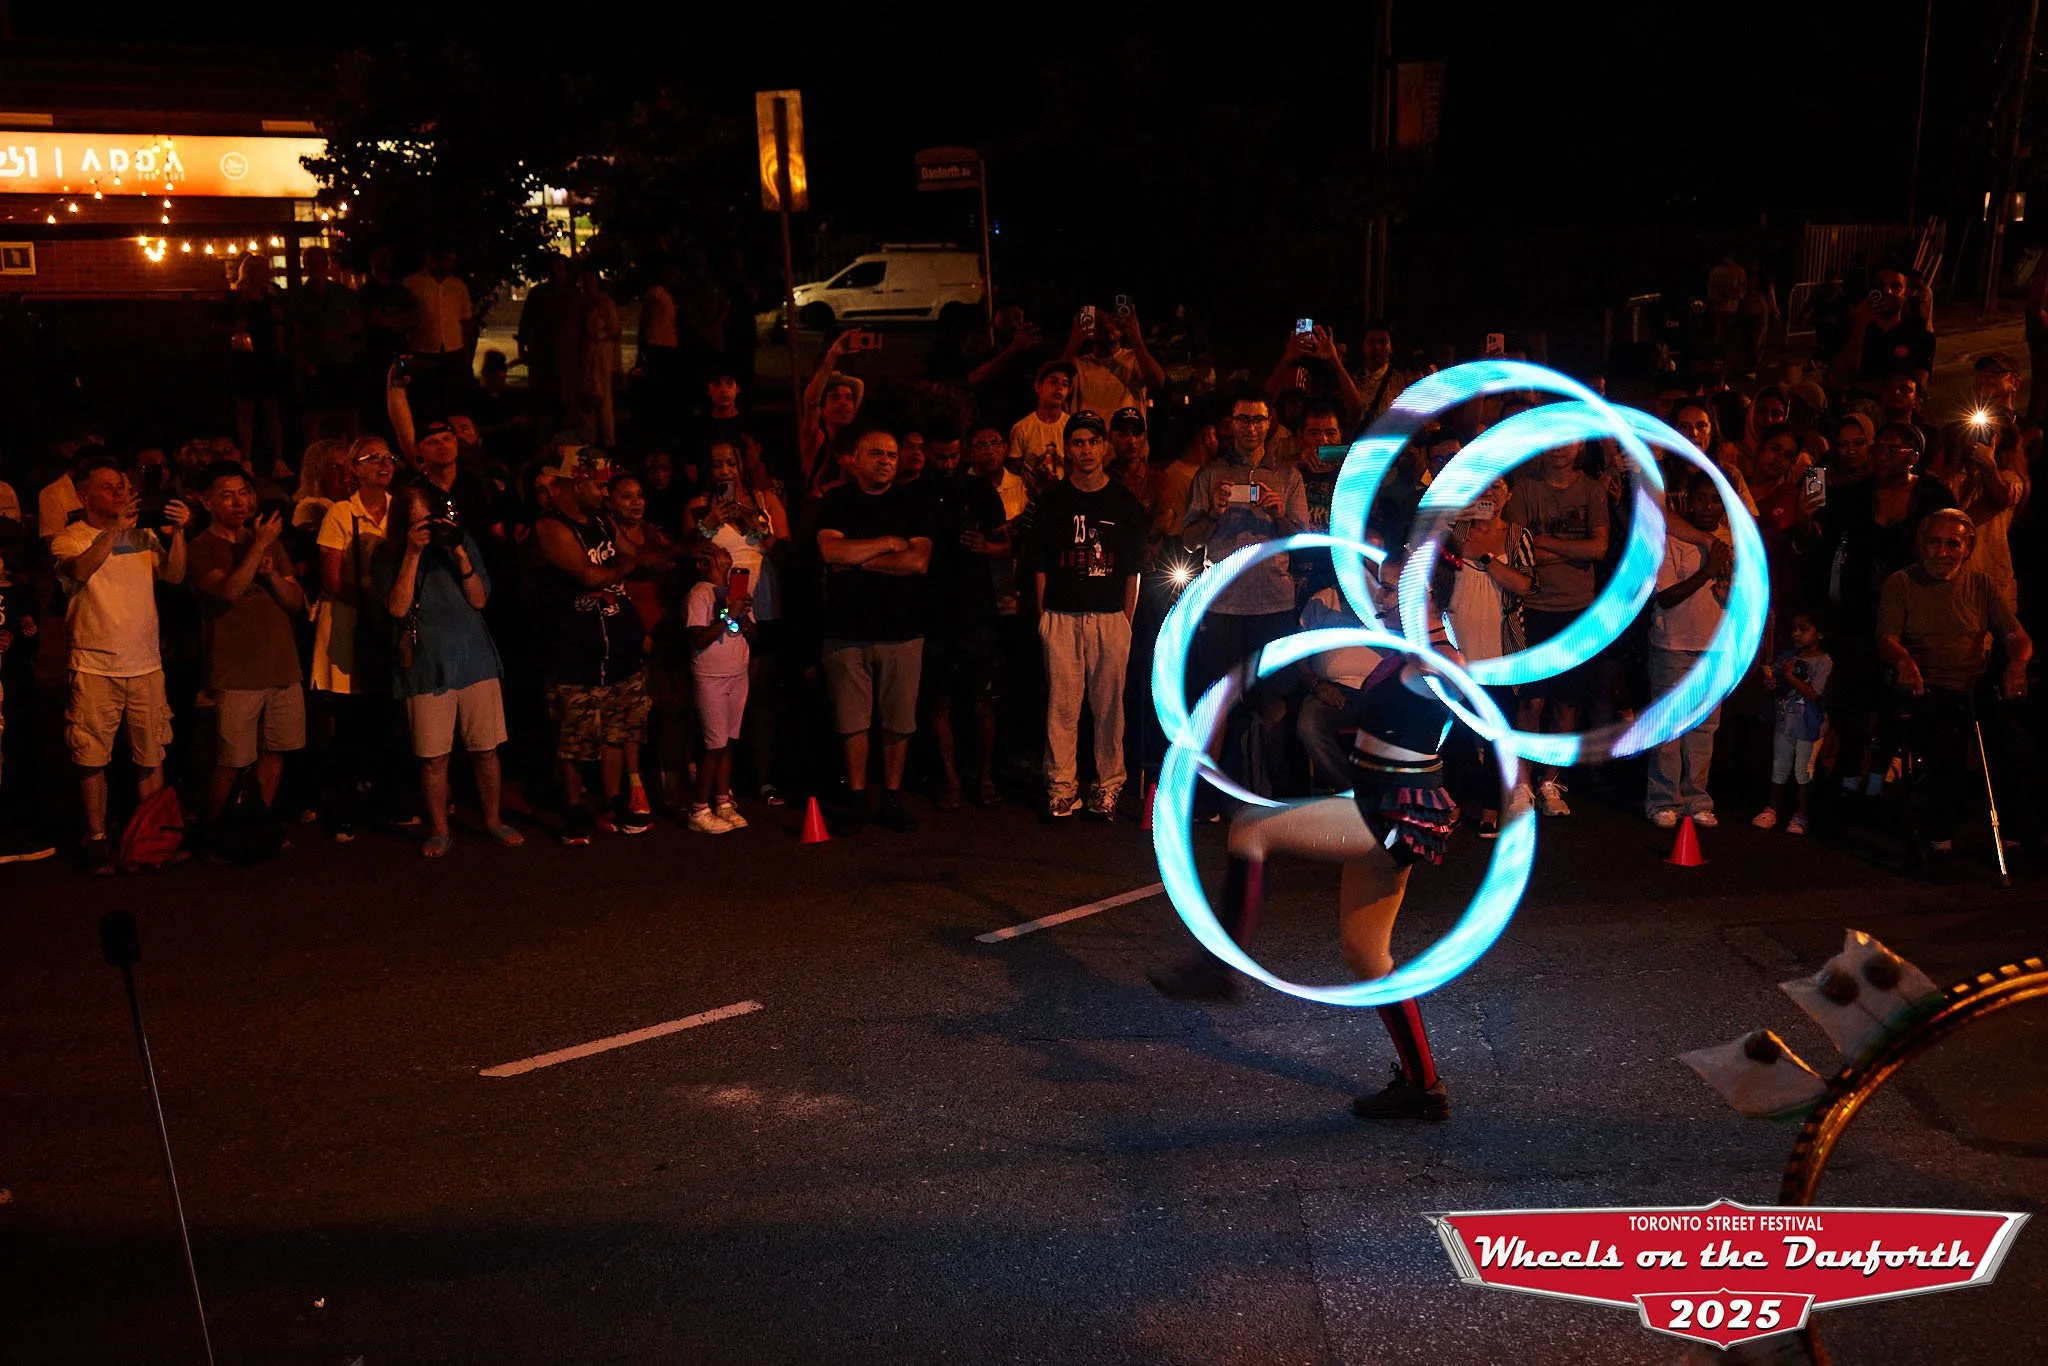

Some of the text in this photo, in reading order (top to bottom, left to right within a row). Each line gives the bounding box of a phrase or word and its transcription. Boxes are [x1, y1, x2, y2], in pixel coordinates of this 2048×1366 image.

[81, 147, 184, 172] ADDA
[921, 165, 960, 179] Danforth
[1073, 513, 1086, 543] 23
